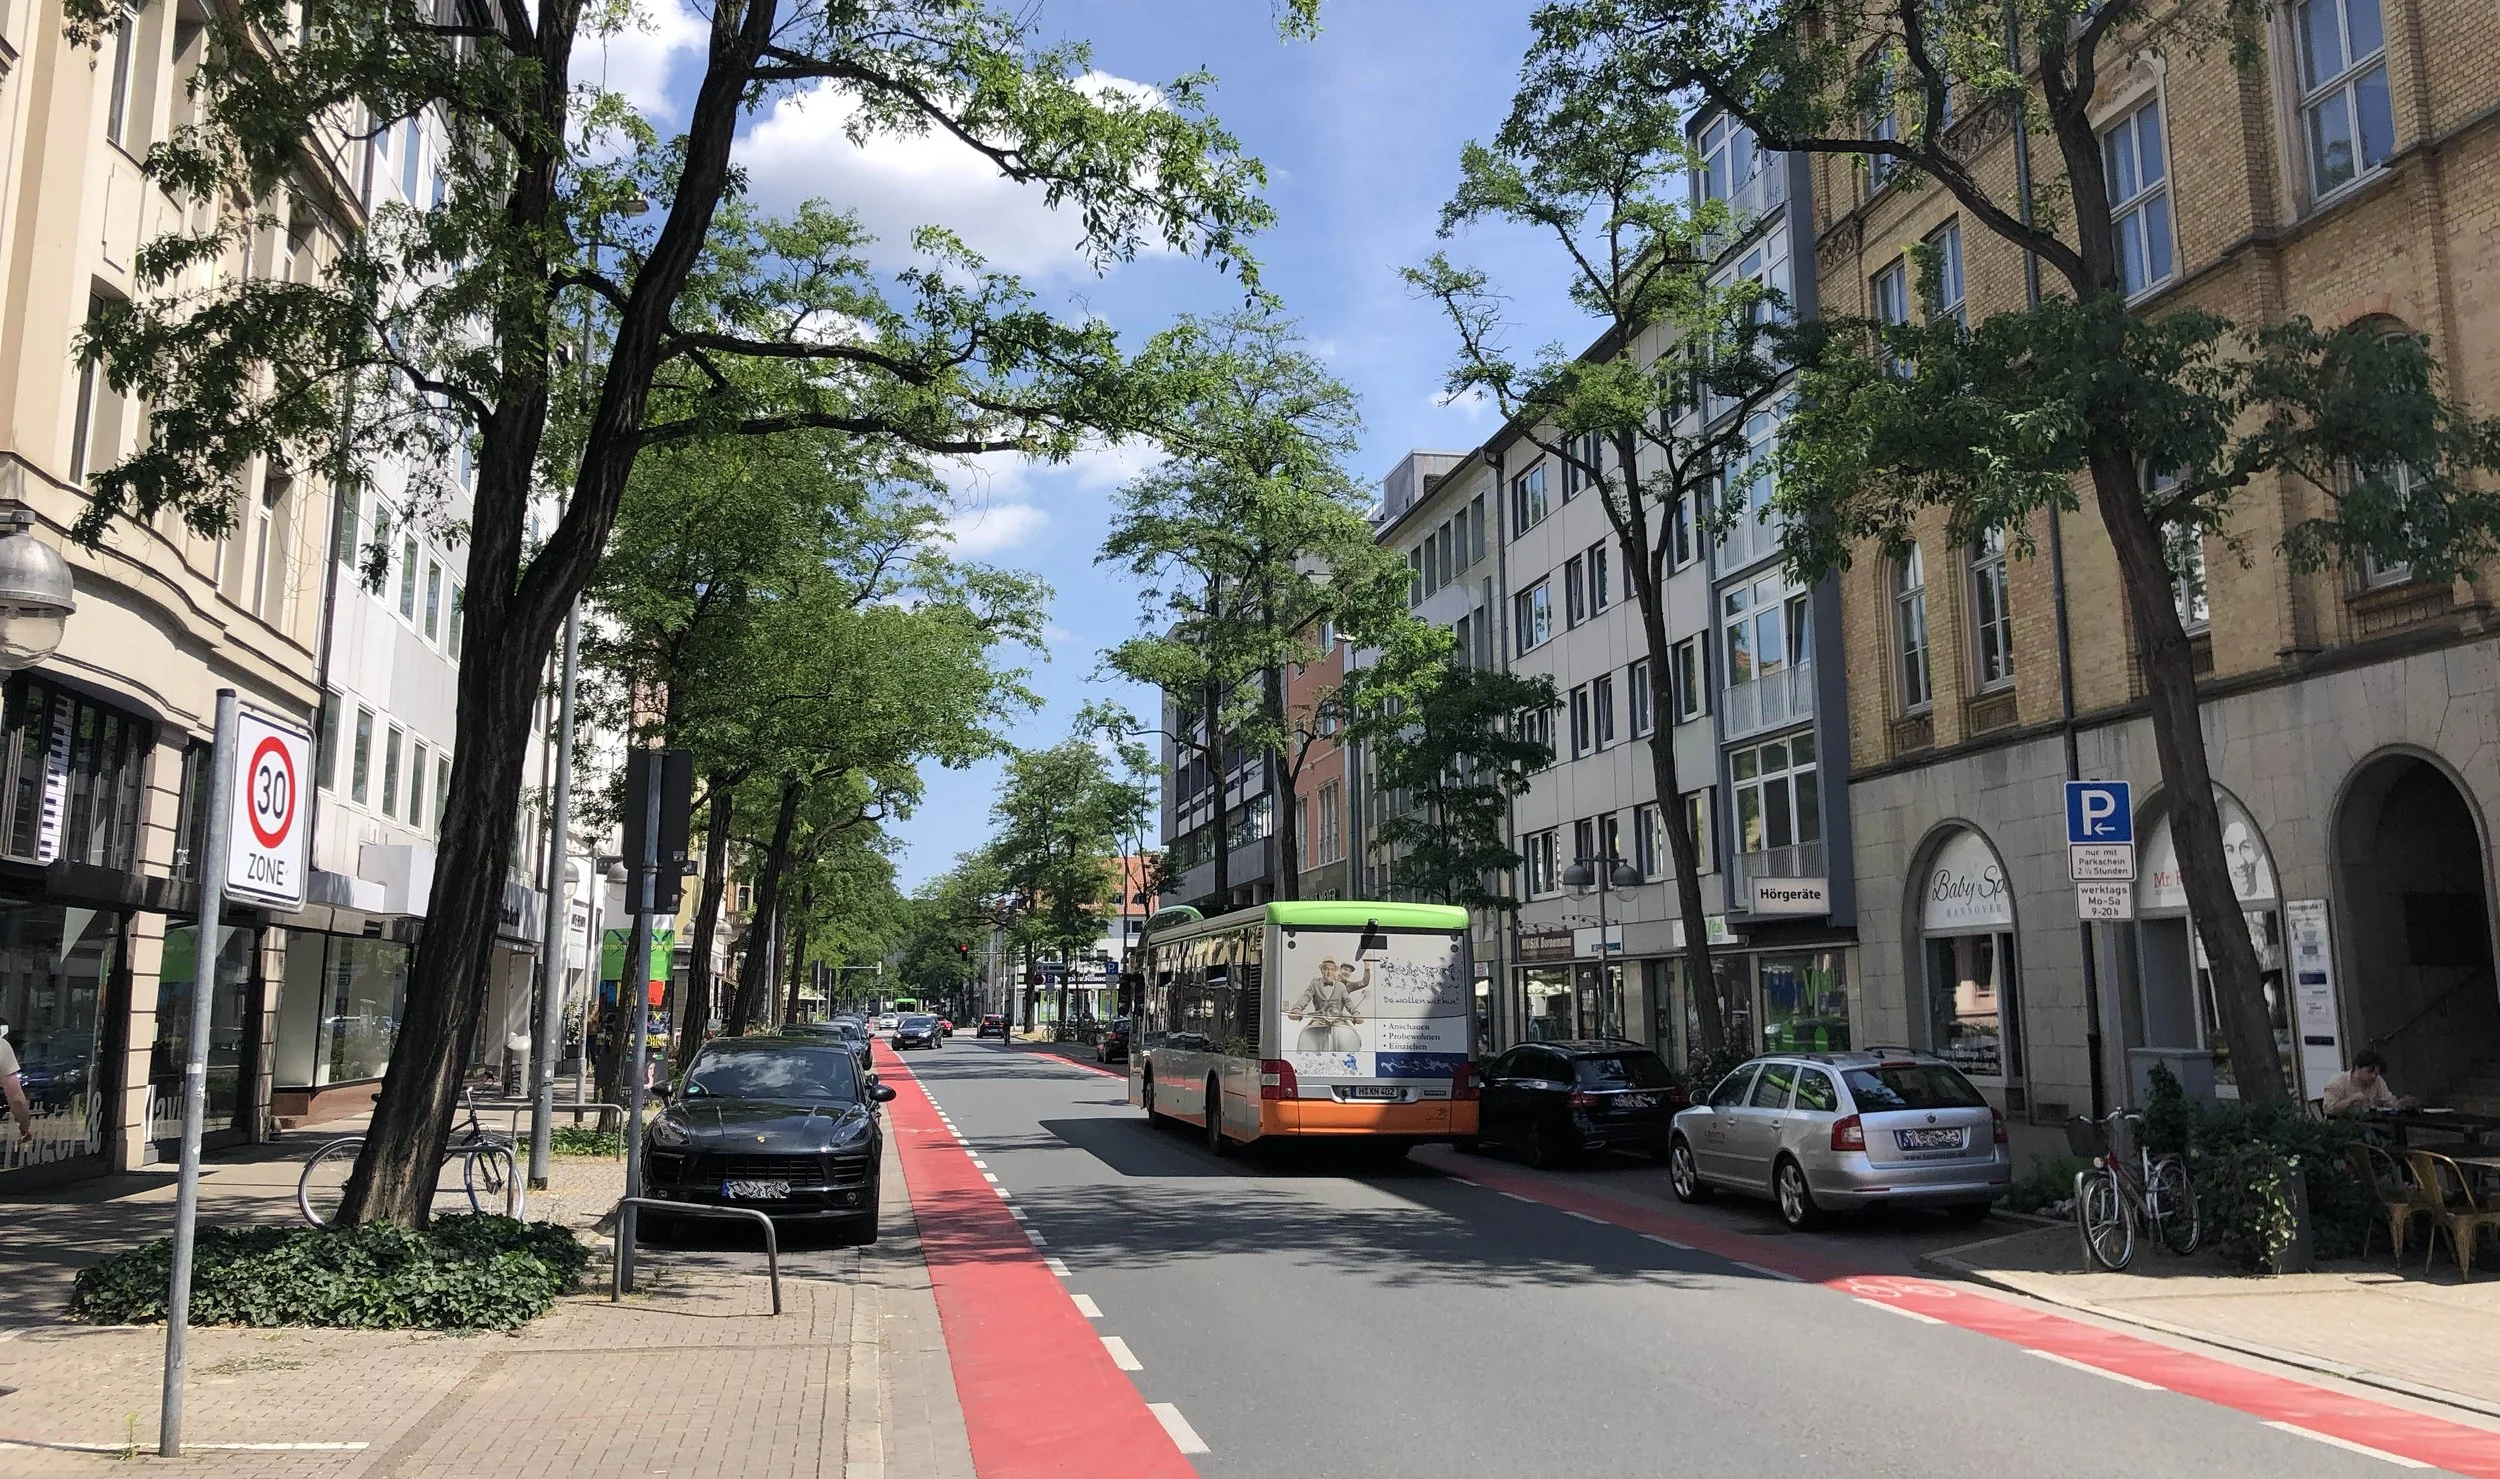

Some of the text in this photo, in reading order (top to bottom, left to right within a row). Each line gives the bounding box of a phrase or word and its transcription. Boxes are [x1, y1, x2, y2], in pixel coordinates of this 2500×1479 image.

[257, 765, 286, 819] 30
[2081, 789, 2116, 836] P
[2103, 848, 2117, 856] mit
[2078, 857, 2125, 865] Parkschein
[247, 853, 285, 886] ZONE
[2093, 867, 2128, 875] Stunden
[1932, 869, 1975, 906] Baby
[2080, 885, 2127, 896] werktags
[1760, 888, 1821, 902] Hörgeräte
[2088, 896, 2121, 906] Mo-Sa
[1946, 903, 2002, 917] HANNOVER
[2091, 907, 2113, 916] 9-20
[1383, 996, 1395, 1004] Da
[1395, 996, 1426, 1005] wollen
[1426, 997, 1440, 1005] wir
[1388, 1032, 1441, 1041] Probewohnen
[1388, 1042, 1428, 1050] Einziehen
[1381, 1088, 1395, 1096] 402
